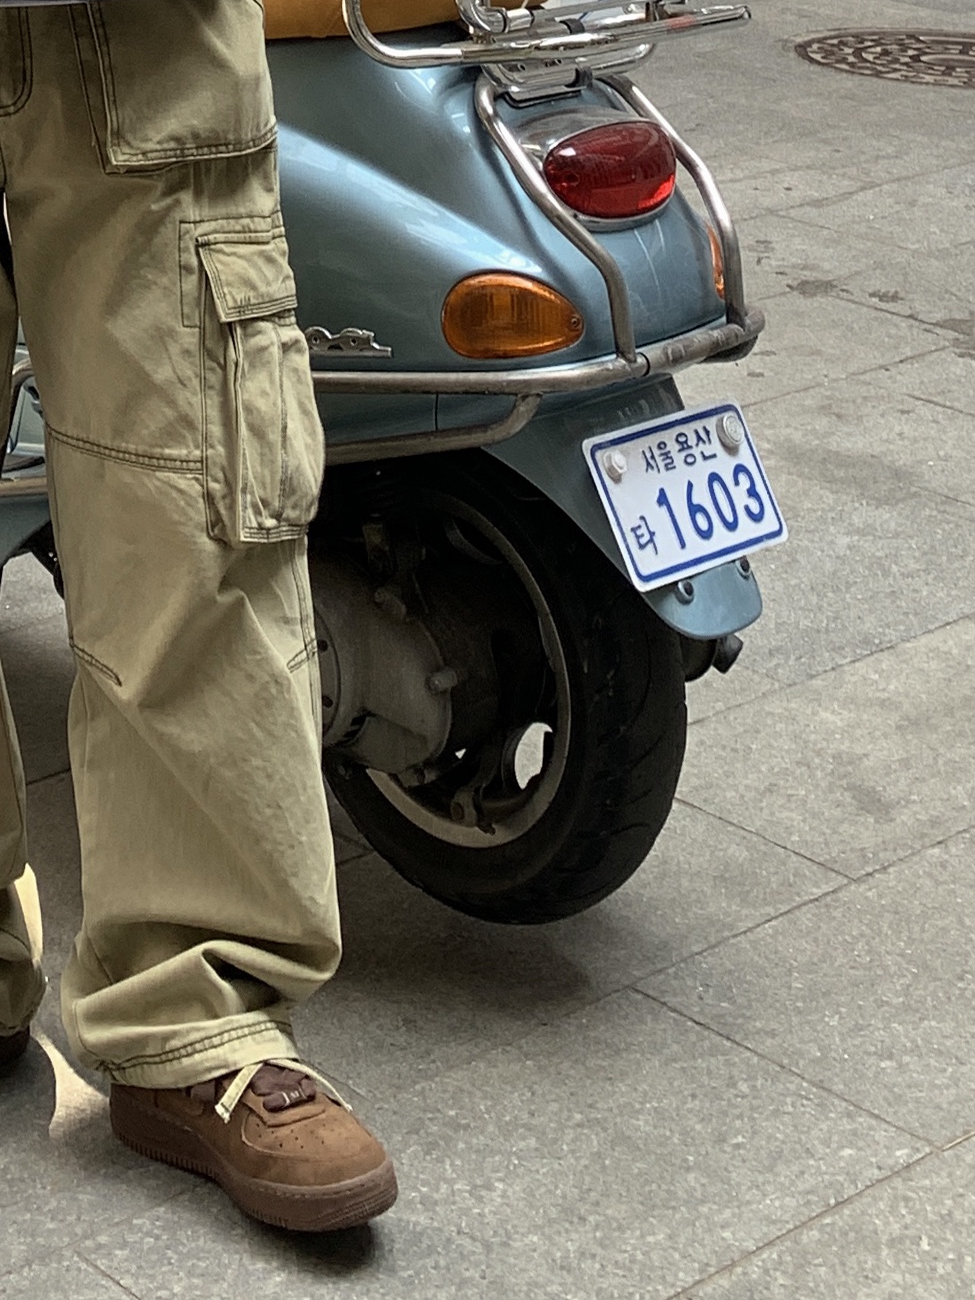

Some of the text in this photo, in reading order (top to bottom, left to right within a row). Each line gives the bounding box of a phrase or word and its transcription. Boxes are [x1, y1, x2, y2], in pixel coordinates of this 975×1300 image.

[641, 425, 718, 474] 서울용산
[630, 463, 765, 555] 타 1603
